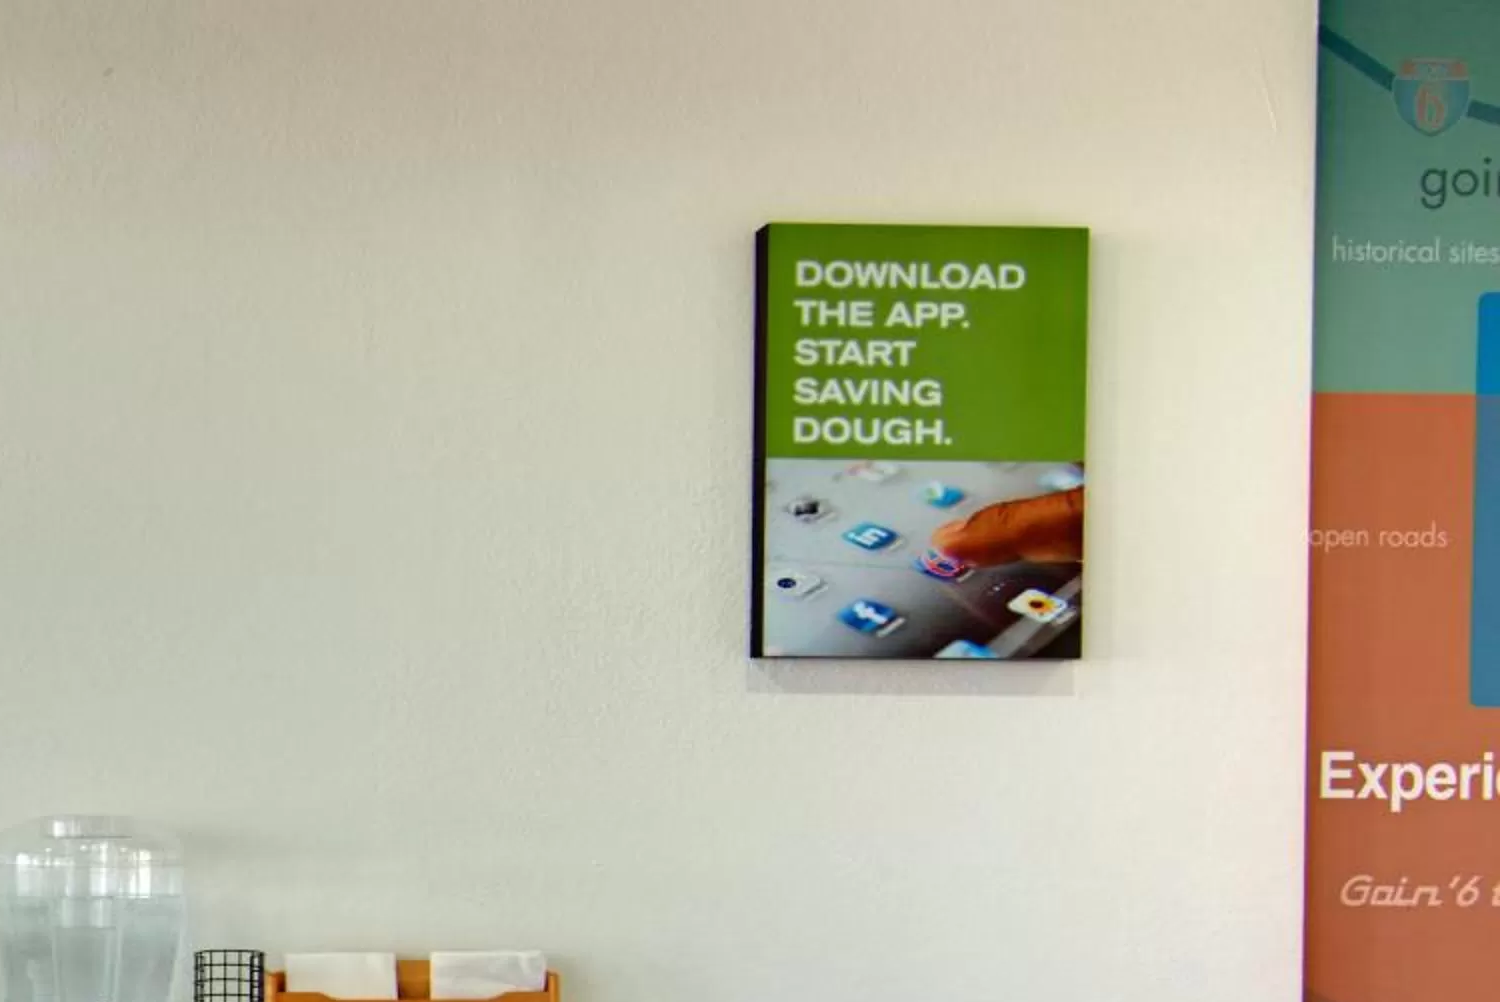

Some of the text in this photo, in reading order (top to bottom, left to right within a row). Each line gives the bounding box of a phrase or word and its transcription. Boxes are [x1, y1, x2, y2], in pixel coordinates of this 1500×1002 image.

[1420, 156, 1500, 210] goi
[1331, 234, 1500, 265] historical sites
[795, 261, 1027, 290] DOWNLOAD
[795, 300, 971, 329] THE APP.
[794, 339, 917, 367] START
[793, 377, 943, 406] SAVING
[792, 416, 953, 446] DOUGH.
[1301, 519, 1449, 553] open roads
[1320, 751, 1500, 813] Experi
[1340, 874, 1444, 907] Gain
